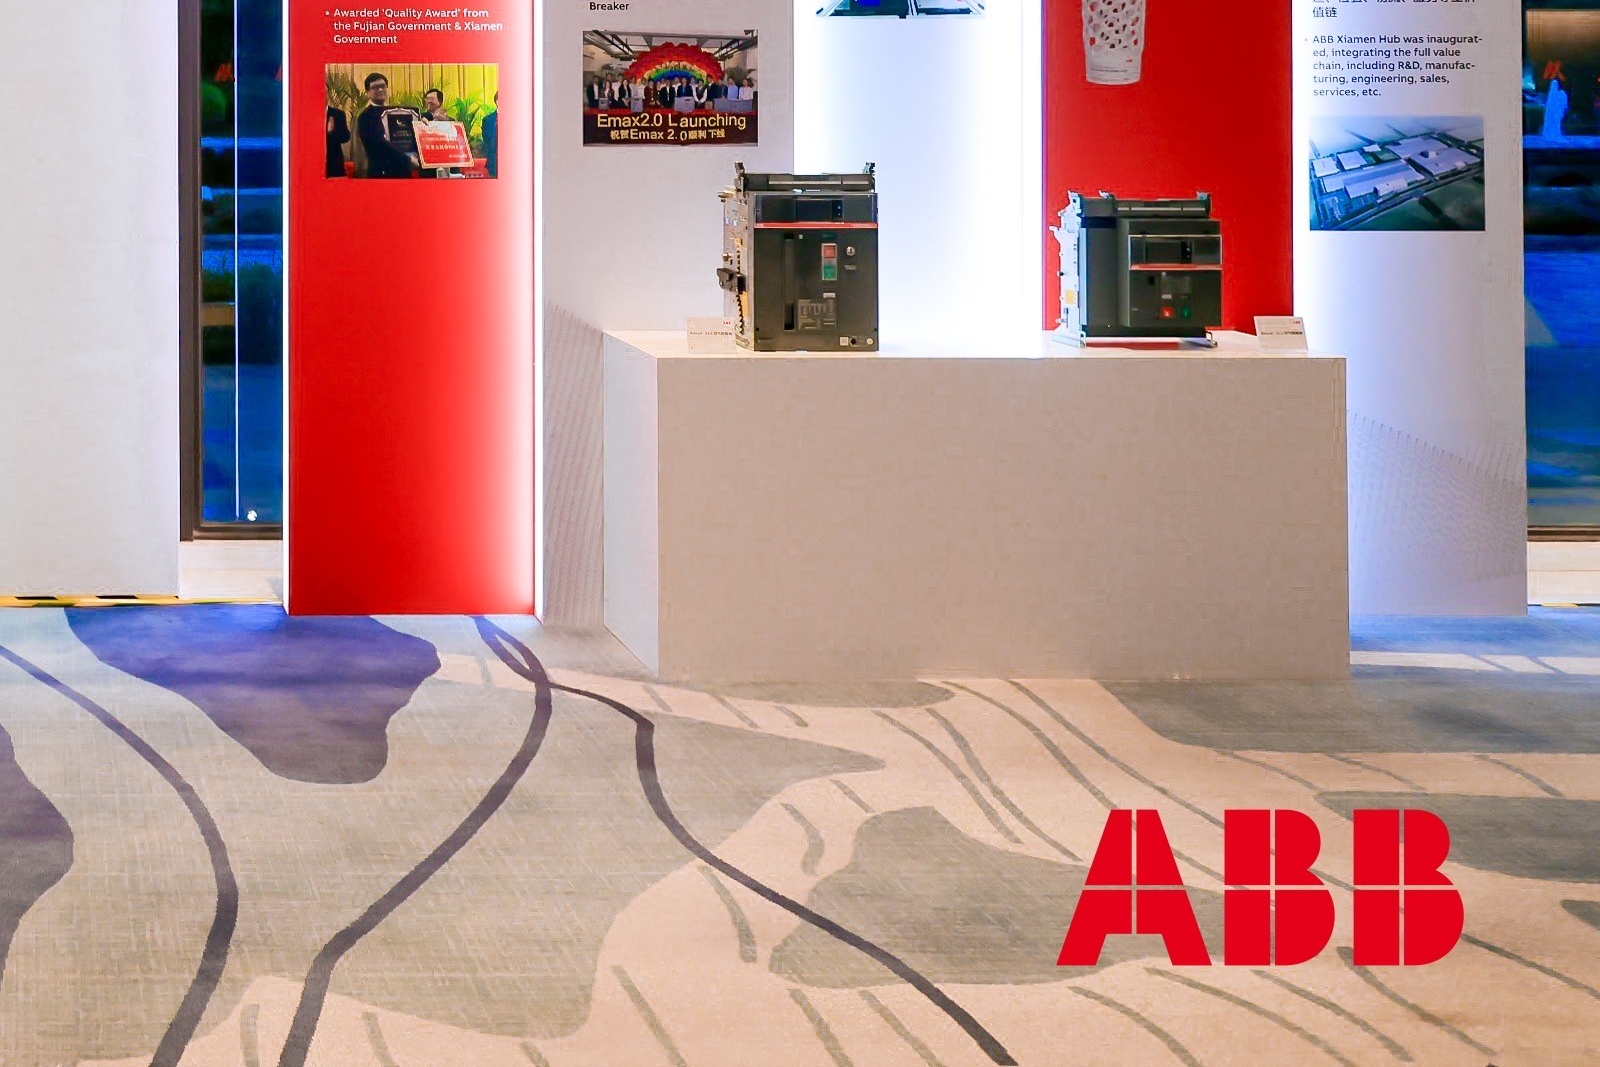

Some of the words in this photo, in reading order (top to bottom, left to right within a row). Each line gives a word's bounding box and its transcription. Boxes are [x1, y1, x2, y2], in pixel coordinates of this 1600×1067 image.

[590, 2, 629, 10] Breaker
[334, 8, 380, 17] Awarded
[463, 8, 488, 17] from
[334, 21, 350, 30] the
[354, 21, 385, 32] Fujian
[387, 22, 451, 31] Government
[453, 22, 461, 30] &
[464, 22, 502, 31] Xiamen
[334, 35, 398, 43] Government
[1338, 35, 1375, 43] Xiamen
[1379, 35, 1400, 43] Hub
[1427, 35, 1482, 45] inaugurat-
[1332, 48, 1390, 58] integrating
[1394, 48, 1410, 56] the
[1414, 48, 1430, 56] full
[1433, 48, 1460, 56] value
[1347, 61, 1394, 71] including
[1426, 61, 1474, 69] manufac-
[597, 113, 663, 127] Emax2.0
